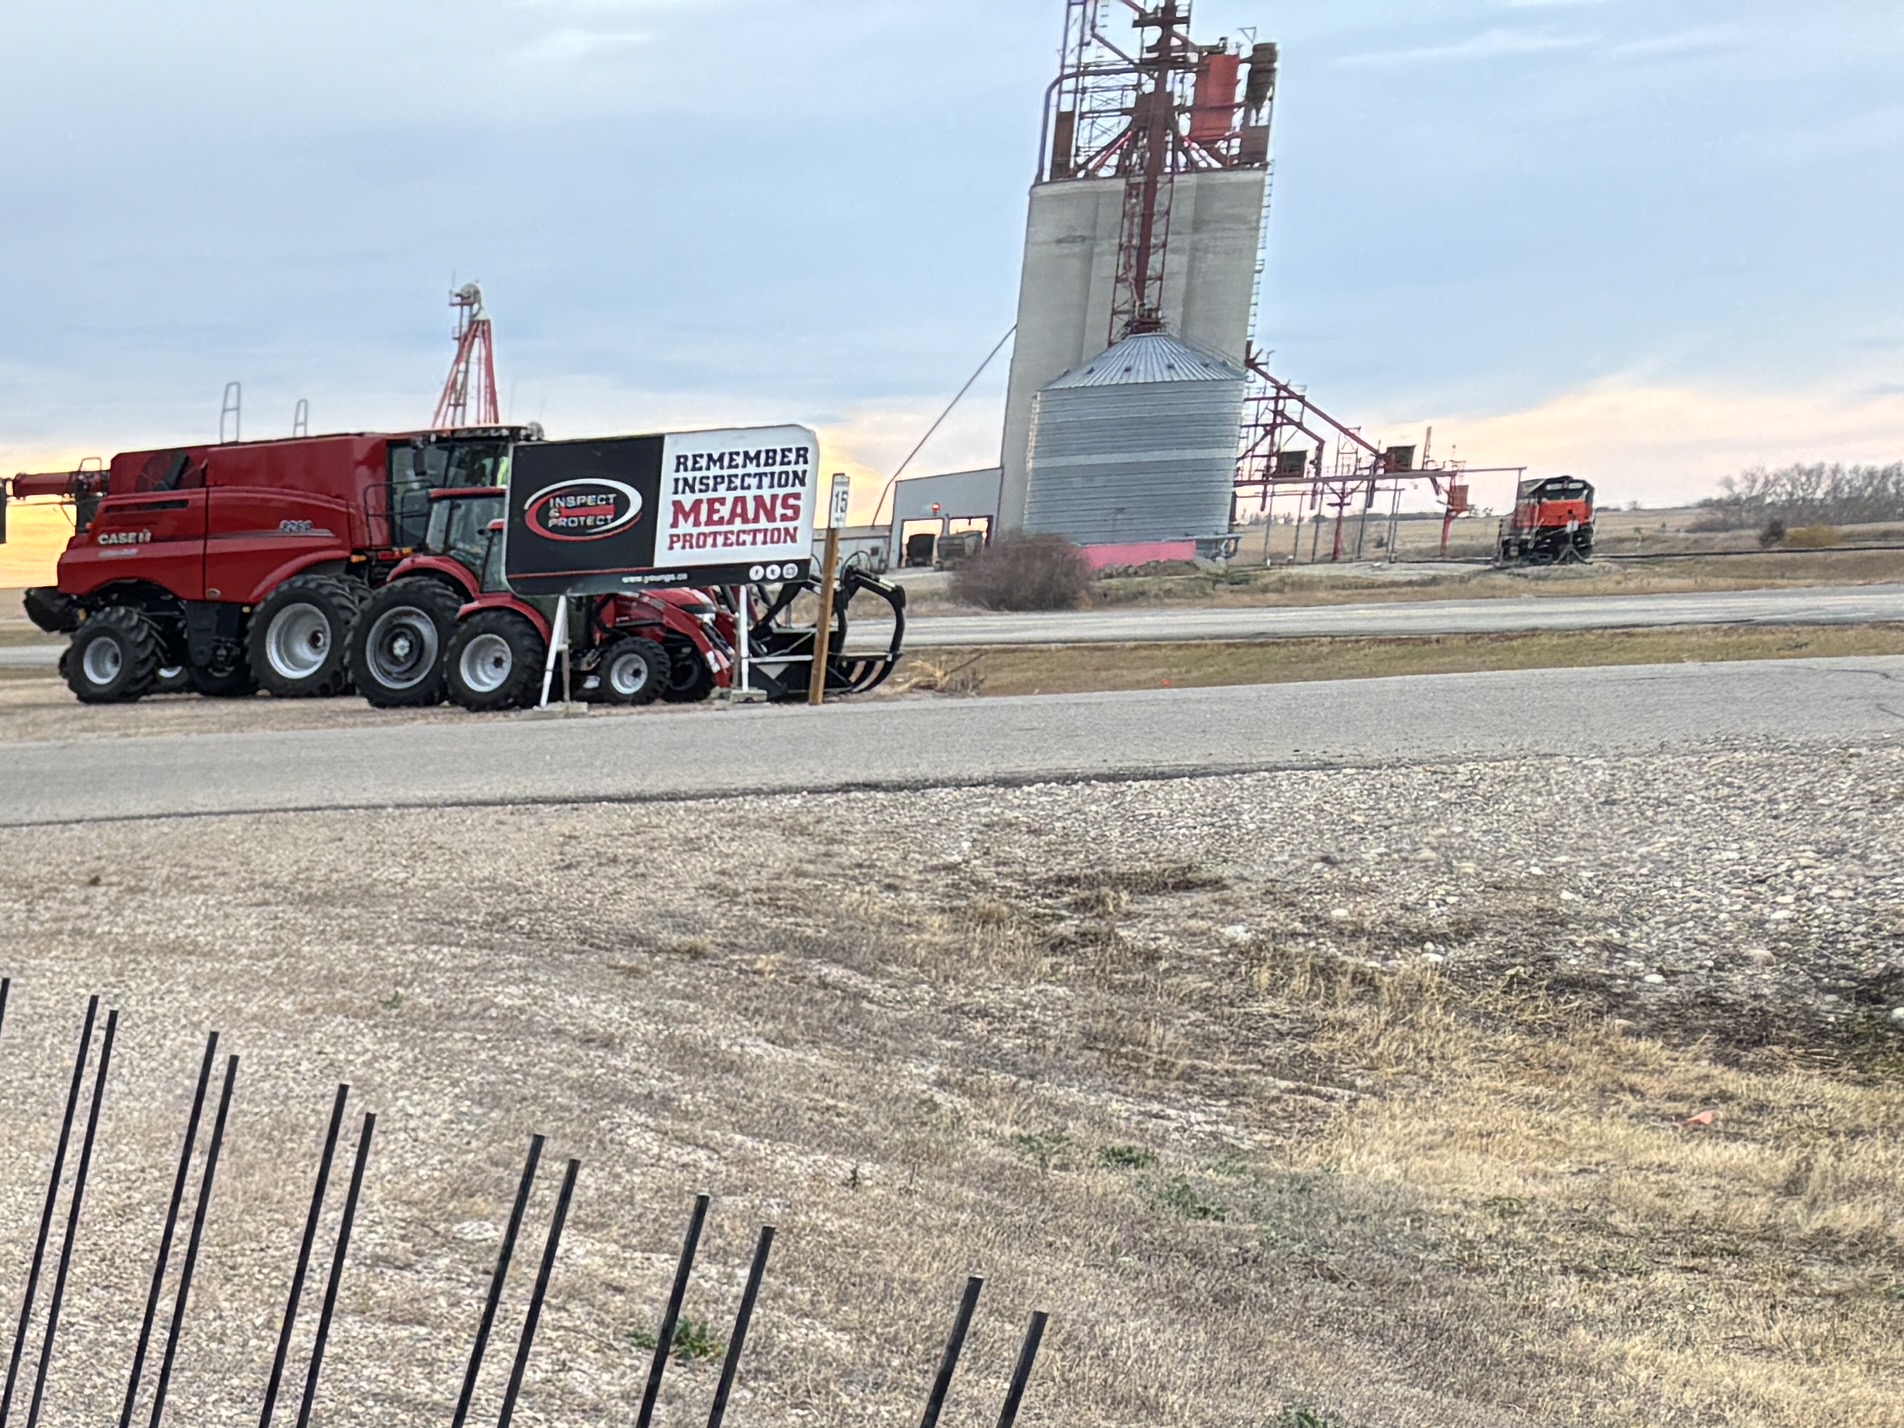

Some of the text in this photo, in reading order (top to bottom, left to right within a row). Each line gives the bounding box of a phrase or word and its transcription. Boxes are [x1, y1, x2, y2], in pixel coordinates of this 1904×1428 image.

[674, 446, 809, 473] REMEMBER
[672, 469, 808, 495] INSPECTION
[549, 494, 617, 508] INSPECT
[669, 492, 802, 529] MEANS
[548, 515, 614, 527] PROTECT
[97, 531, 137, 545] CASE
[668, 526, 798, 551] PROTECTION
